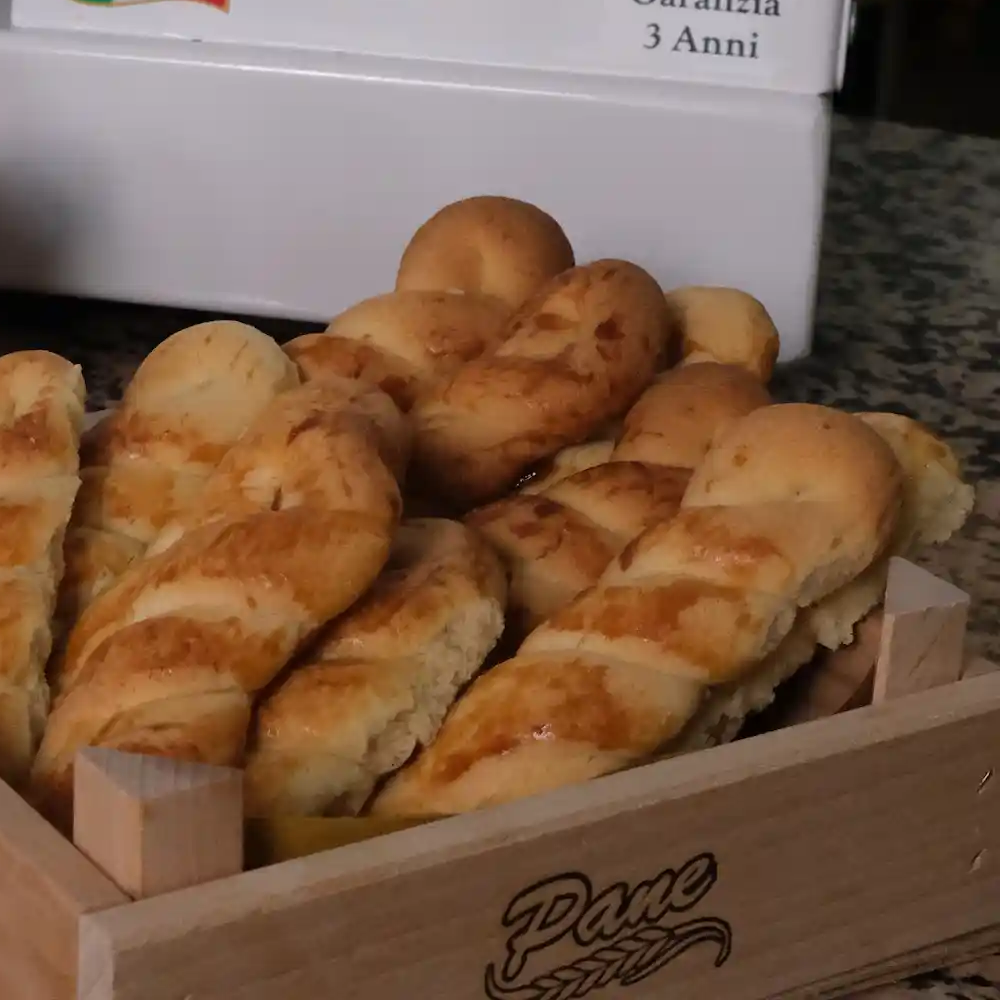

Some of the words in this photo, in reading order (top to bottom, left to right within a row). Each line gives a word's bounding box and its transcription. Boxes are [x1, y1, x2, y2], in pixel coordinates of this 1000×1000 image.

[643, 23, 661, 49] 3
[672, 25, 759, 59] Anni
[502, 852, 717, 982] Pane
